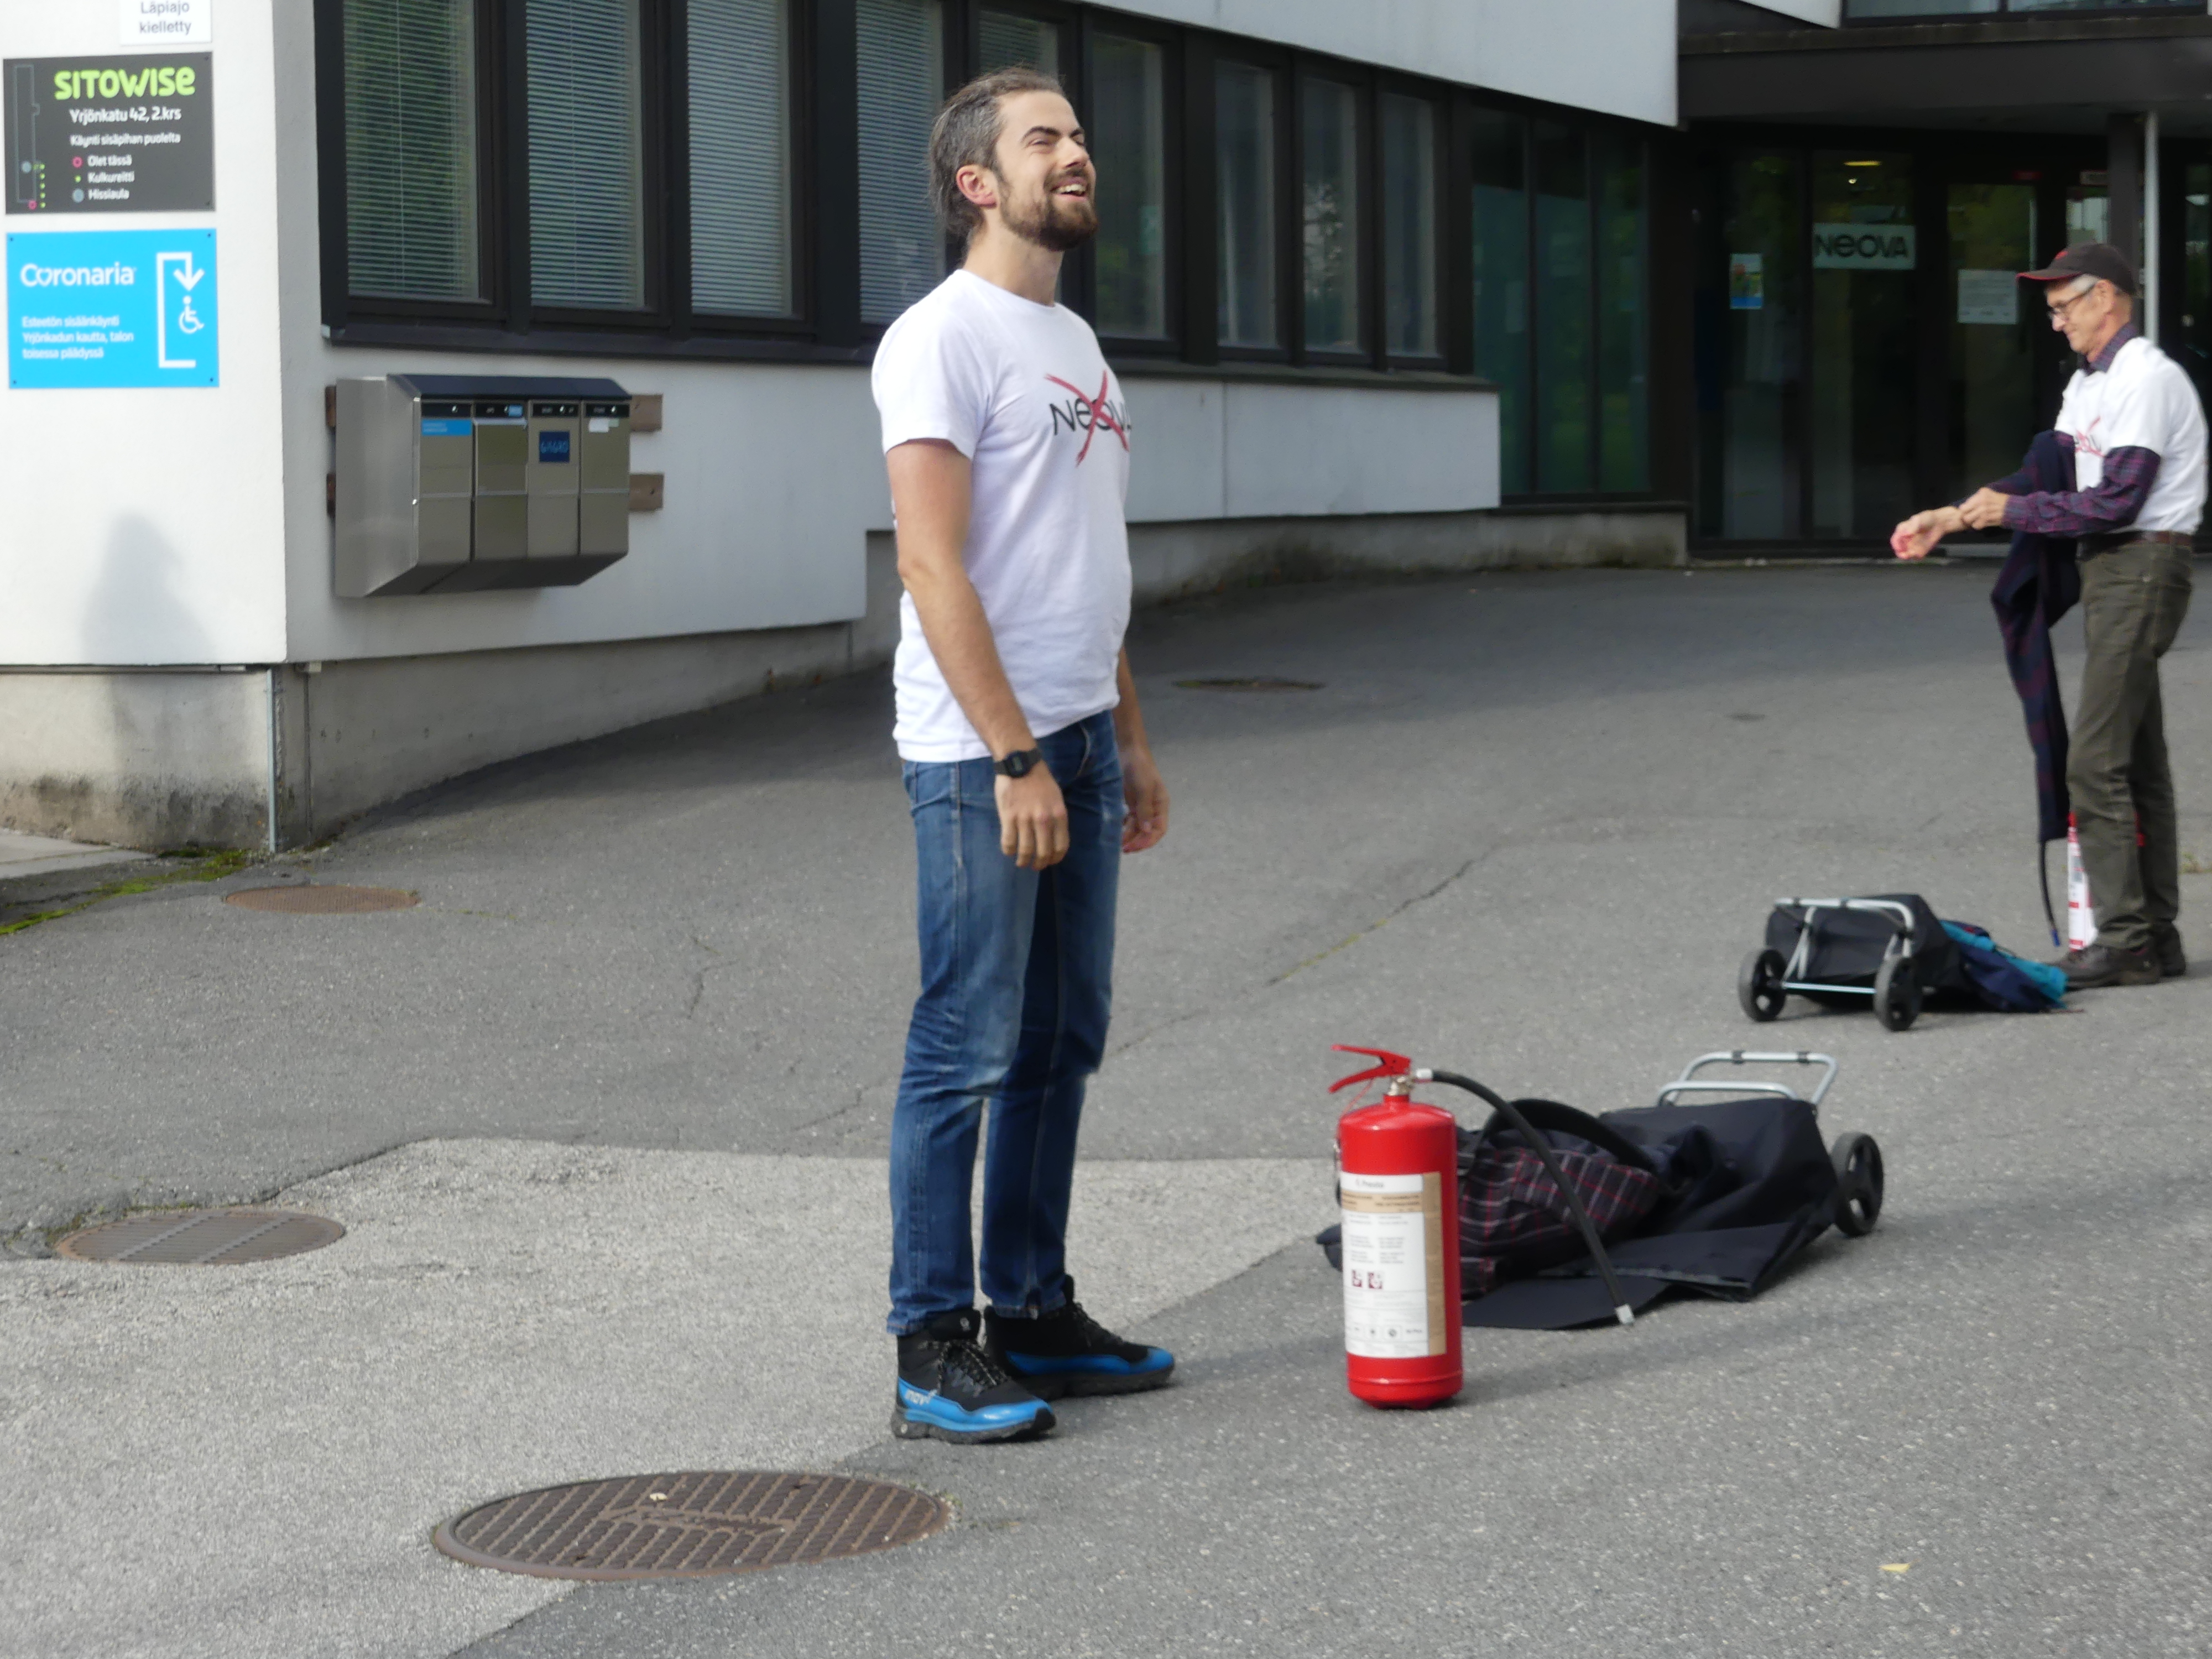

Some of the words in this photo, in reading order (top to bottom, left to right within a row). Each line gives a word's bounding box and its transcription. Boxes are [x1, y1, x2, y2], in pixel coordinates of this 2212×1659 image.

[140, 1, 189, 16] Läpiajo
[139, 20, 191, 35] kielletty
[69, 108, 128, 126] Yrjönkatu
[129, 106, 150, 123] 42,
[151, 106, 182, 121] 2.krs
[70, 134, 100, 148] Käynti
[87, 154, 107, 166] Olet
[108, 153, 132, 166] tässä
[20, 262, 134, 287] Coronaria
[109, 330, 134, 342] talon
